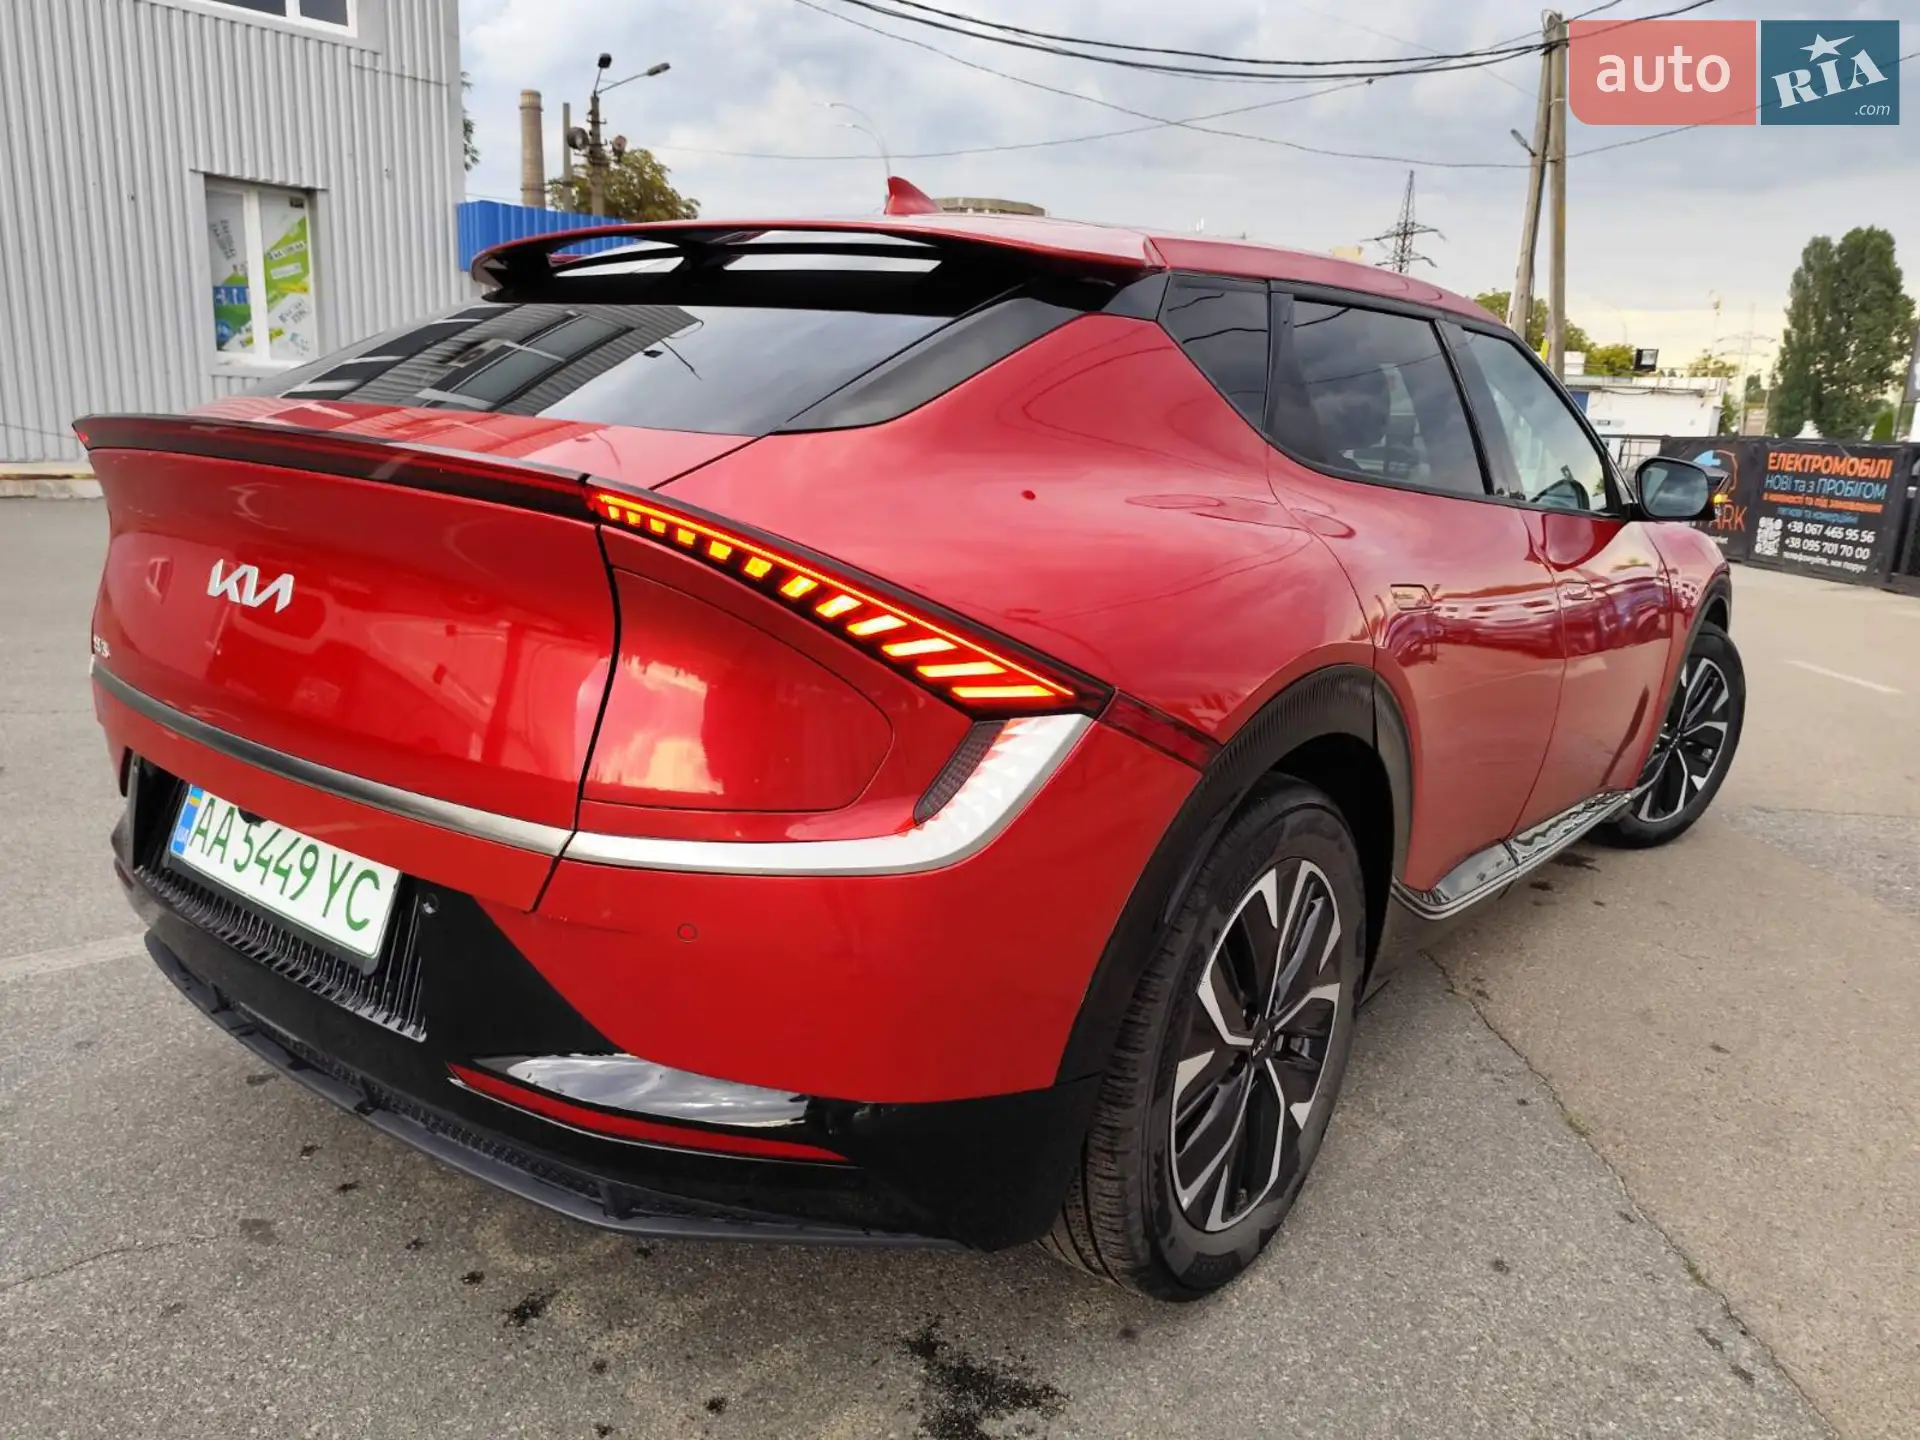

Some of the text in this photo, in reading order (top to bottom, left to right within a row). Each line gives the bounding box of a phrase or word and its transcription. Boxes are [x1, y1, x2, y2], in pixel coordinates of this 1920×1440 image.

[1767, 452, 1892, 478] ЕЛЕКТРОМОБІЛІ
[1764, 473, 1887, 499] НОВІ та з ПРОБІГОМ
[1787, 520, 1803, 532] +38
[1804, 522, 1823, 534] 067
[1845, 528, 1859, 540] 95
[1860, 530, 1875, 542] 56
[1802, 539, 1819, 551] 095
[1821, 542, 1837, 554] 701
[1840, 544, 1853, 556] 70
[1855, 547, 1870, 559] 00
[189, 797, 380, 932] AA 5449 YC
